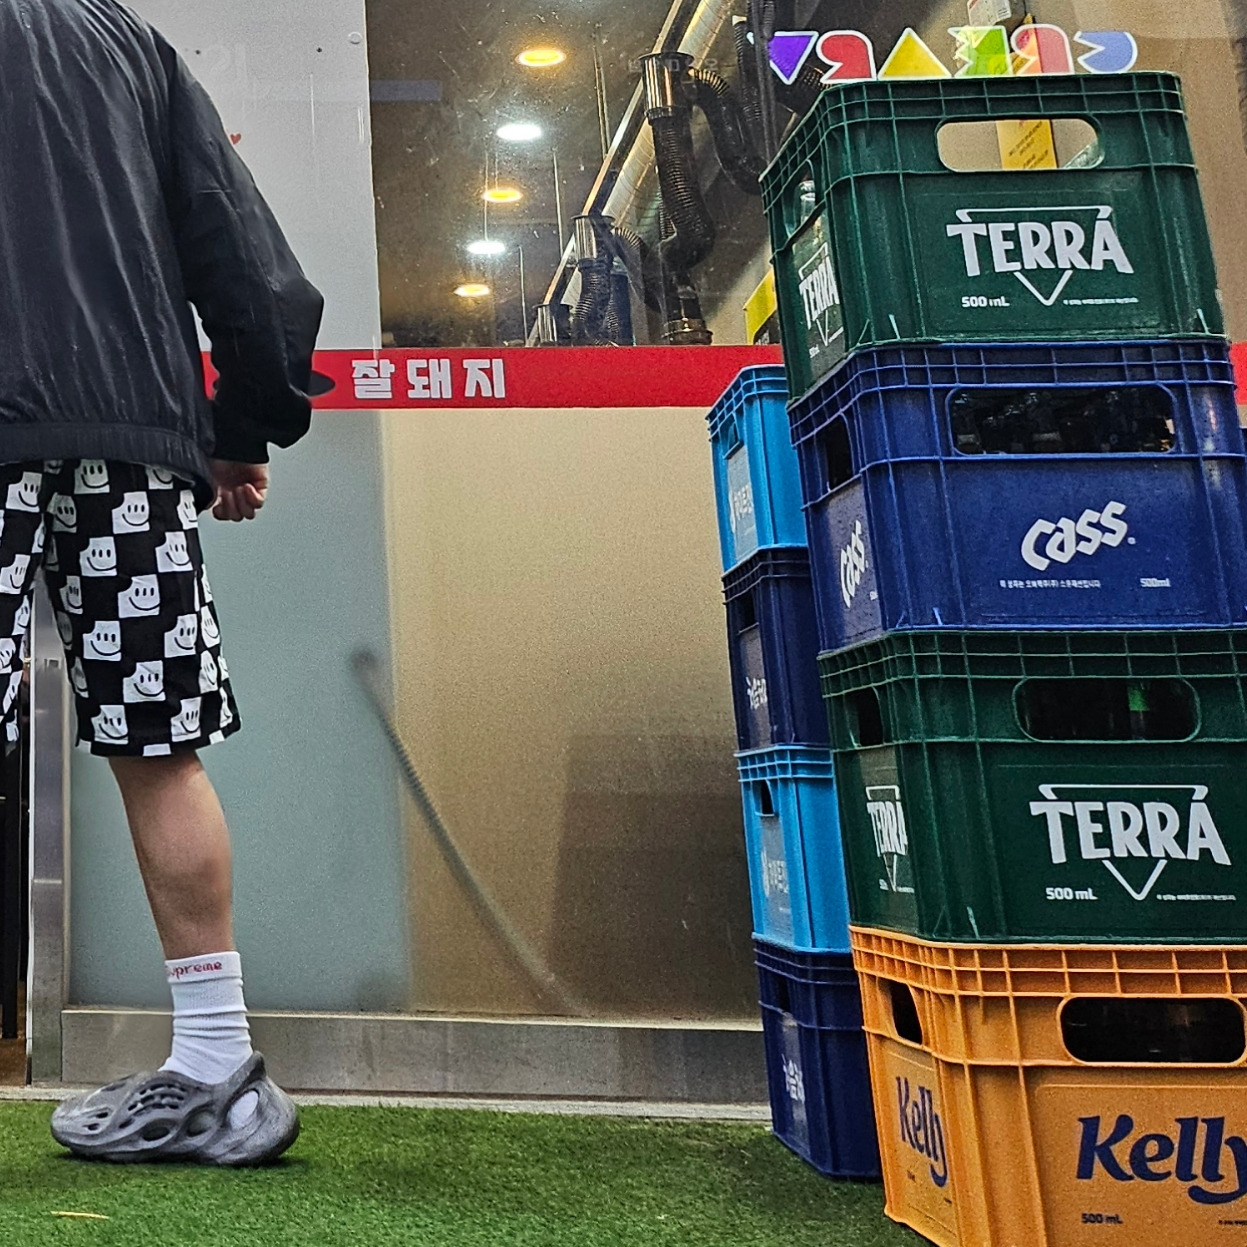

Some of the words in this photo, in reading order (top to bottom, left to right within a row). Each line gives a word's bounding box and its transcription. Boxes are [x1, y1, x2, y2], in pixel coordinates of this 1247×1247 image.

[946, 220, 1135, 277] TERRA
[798, 256, 840, 331] TERRA
[866, 801, 908, 858] TERRA
[1029, 800, 1232, 866] TERRA
[1045, 887, 1074, 900] 500
[1075, 887, 1098, 900] mL
[896, 1076, 949, 1188] Kelly
[1076, 1113, 1247, 1205] Kelly
[1081, 1213, 1103, 1224] 500
